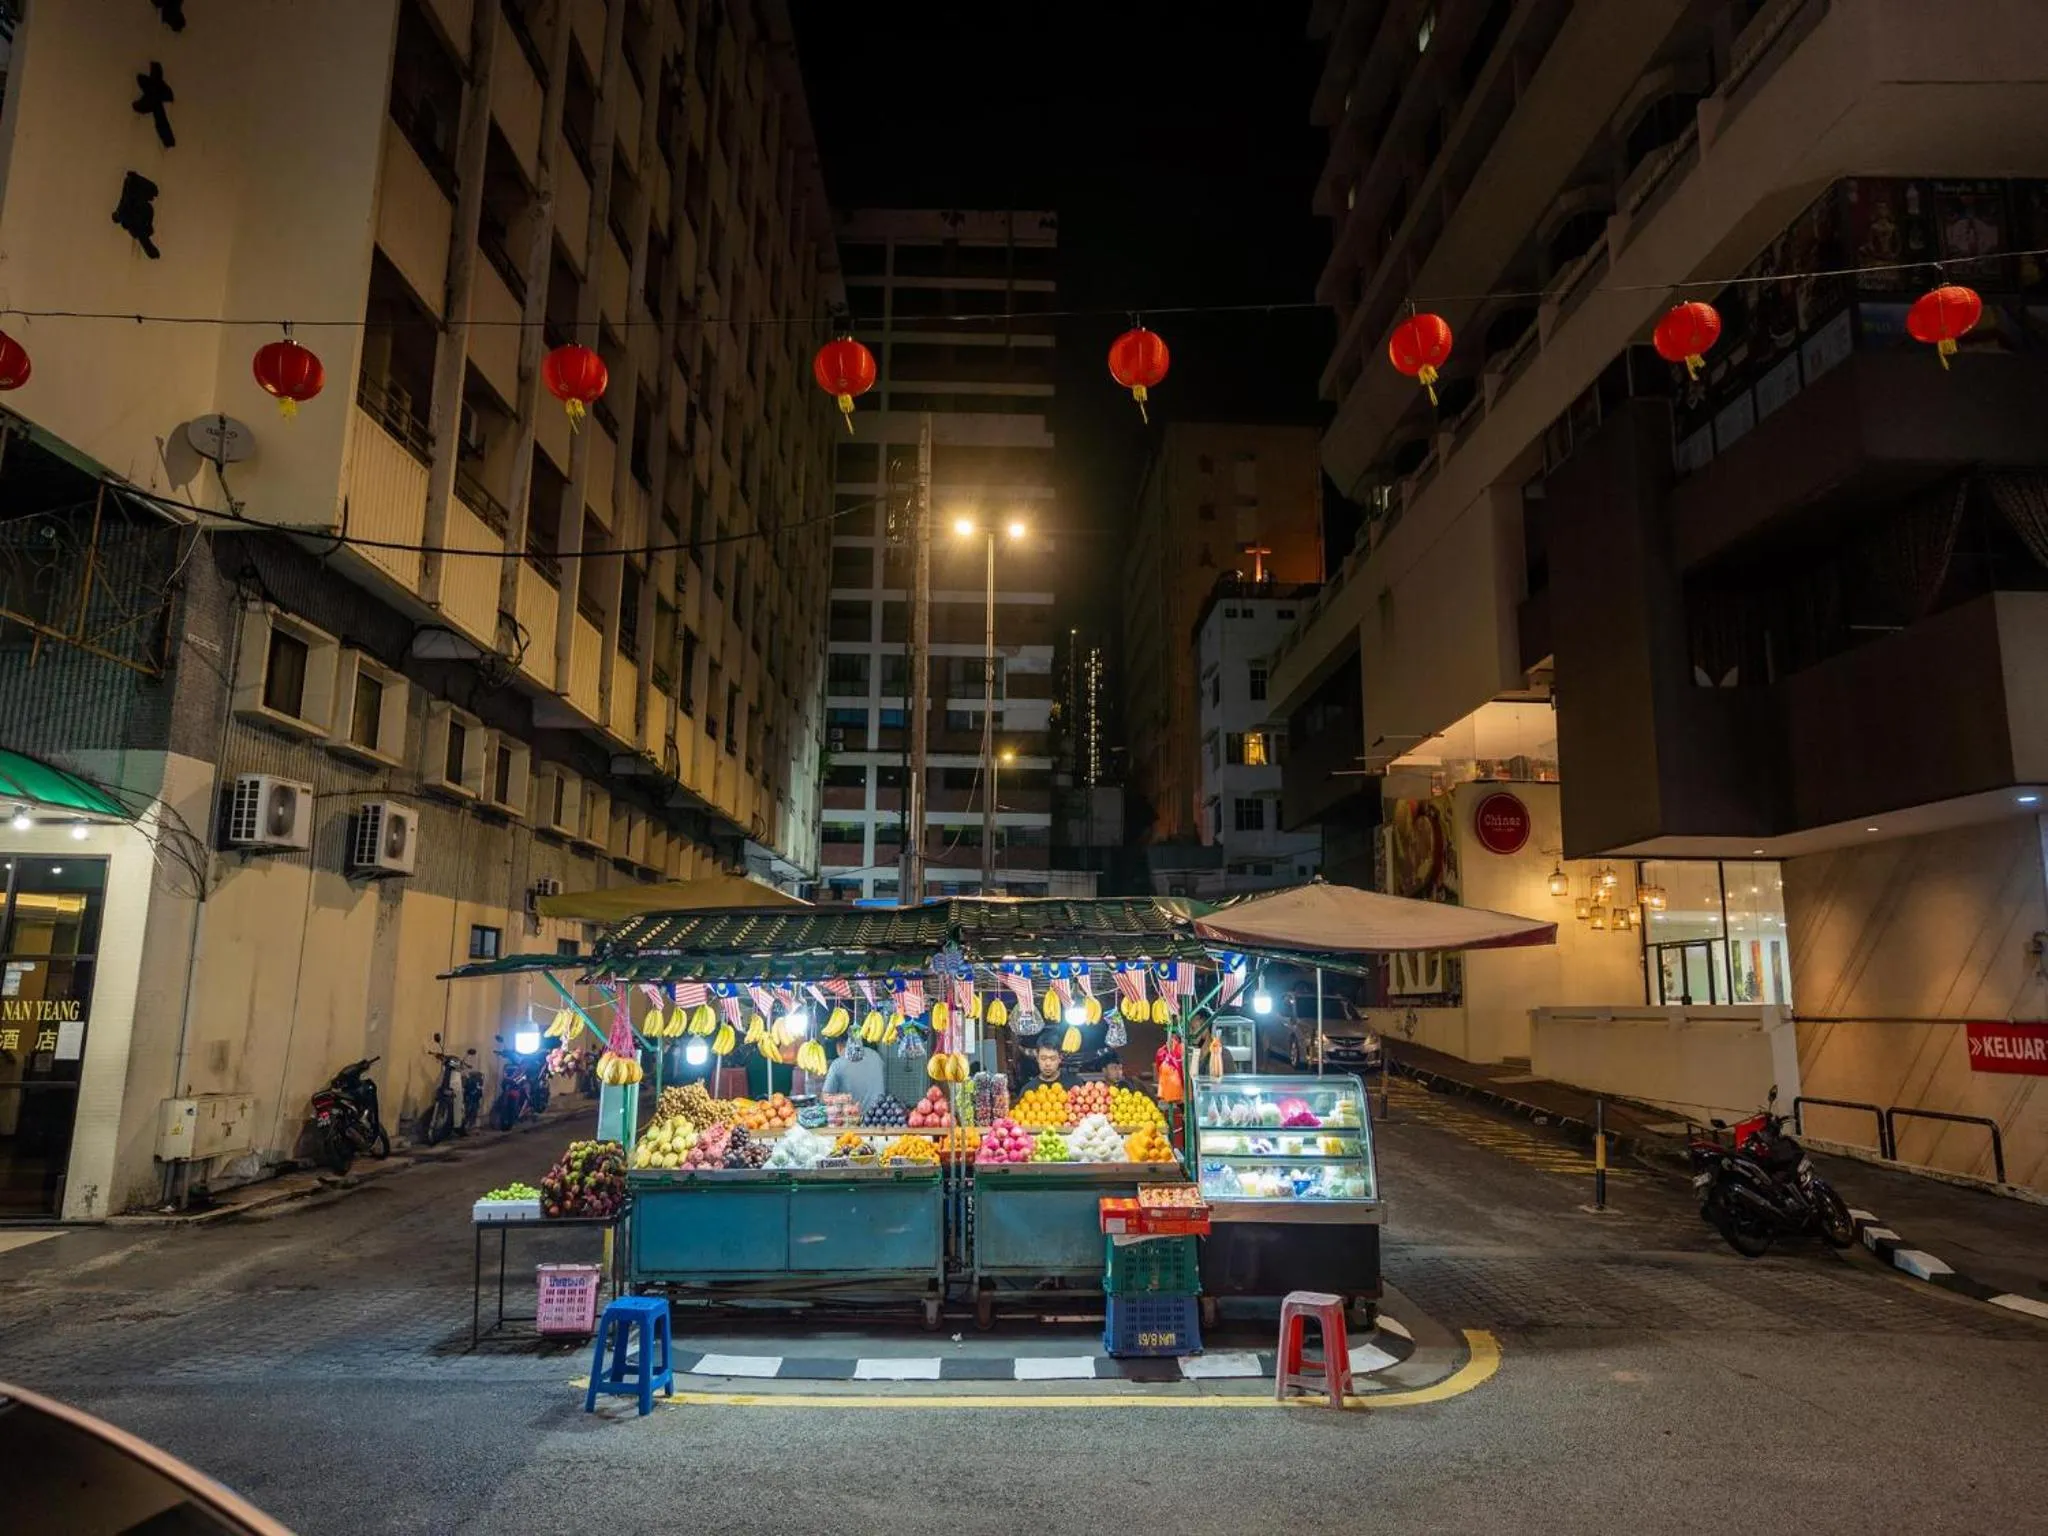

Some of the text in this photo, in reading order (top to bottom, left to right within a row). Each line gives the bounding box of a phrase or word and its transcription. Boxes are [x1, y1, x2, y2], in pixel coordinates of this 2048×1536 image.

[2, 1000, 80, 1021] NAN YEANG
[1983, 1036, 2047, 1061] KELUAR
